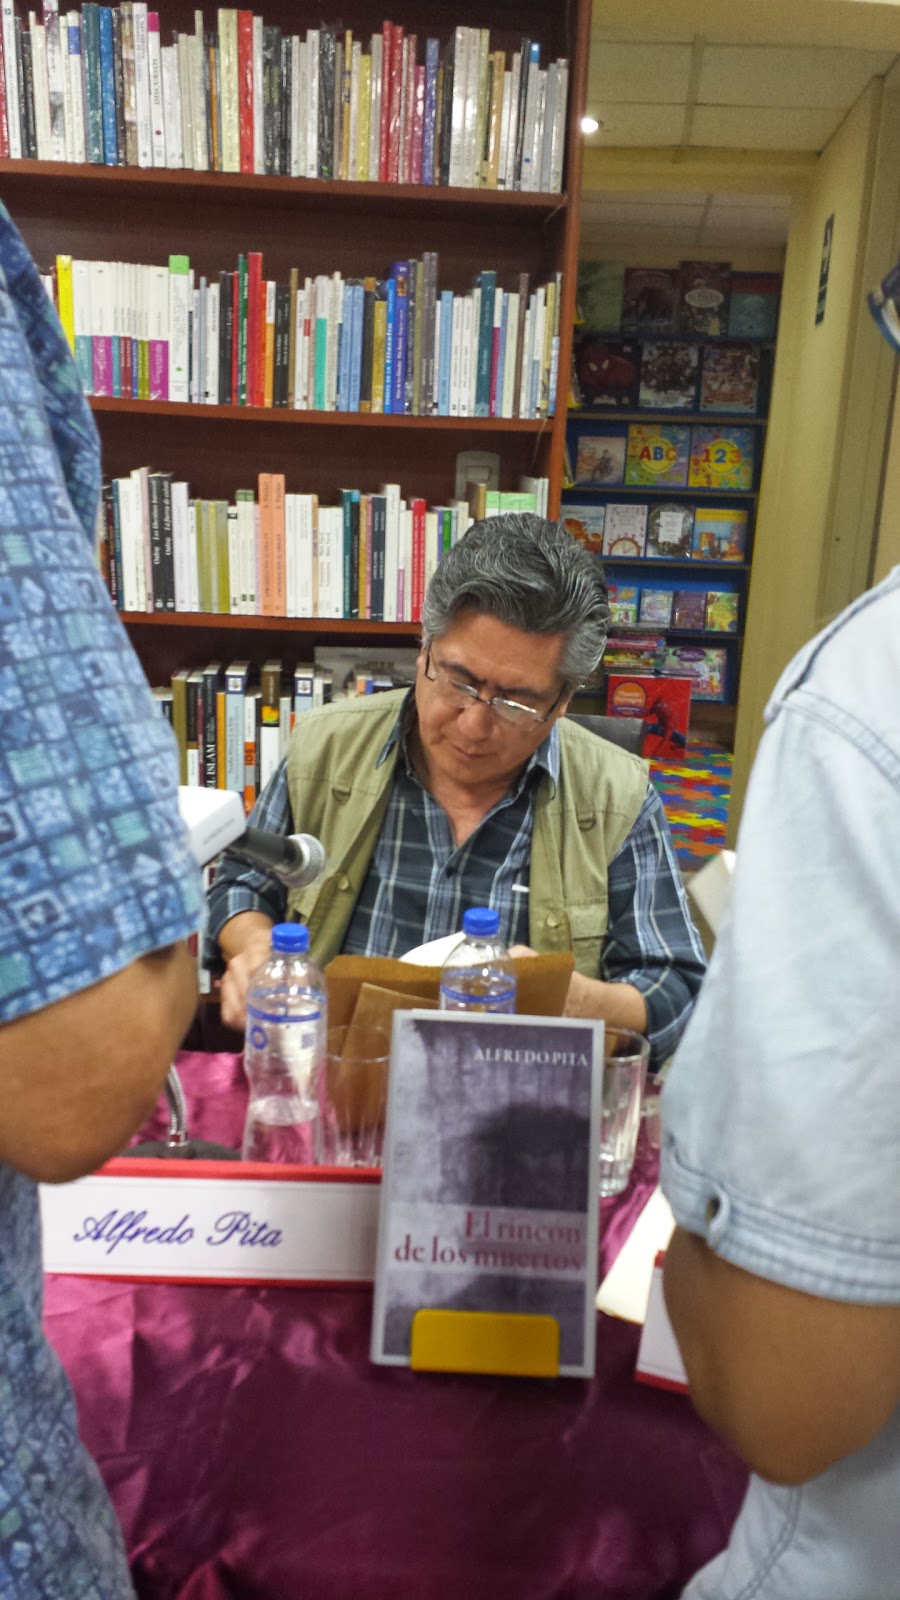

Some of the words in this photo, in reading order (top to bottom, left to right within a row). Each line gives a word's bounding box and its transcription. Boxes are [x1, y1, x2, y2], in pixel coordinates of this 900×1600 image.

[639, 446, 676, 461] ABC
[206, 744, 216, 775] ISLAM
[474, 1046, 550, 1065] ALFREDO
[552, 1051, 588, 1067] PITA
[73, 1209, 194, 1254] Alfredo
[206, 1211, 284, 1248] Pita
[465, 1210, 490, 1238] El
[394, 1234, 425, 1263] de
[432, 1235, 467, 1264] los
[474, 1248, 582, 1271] muertos
